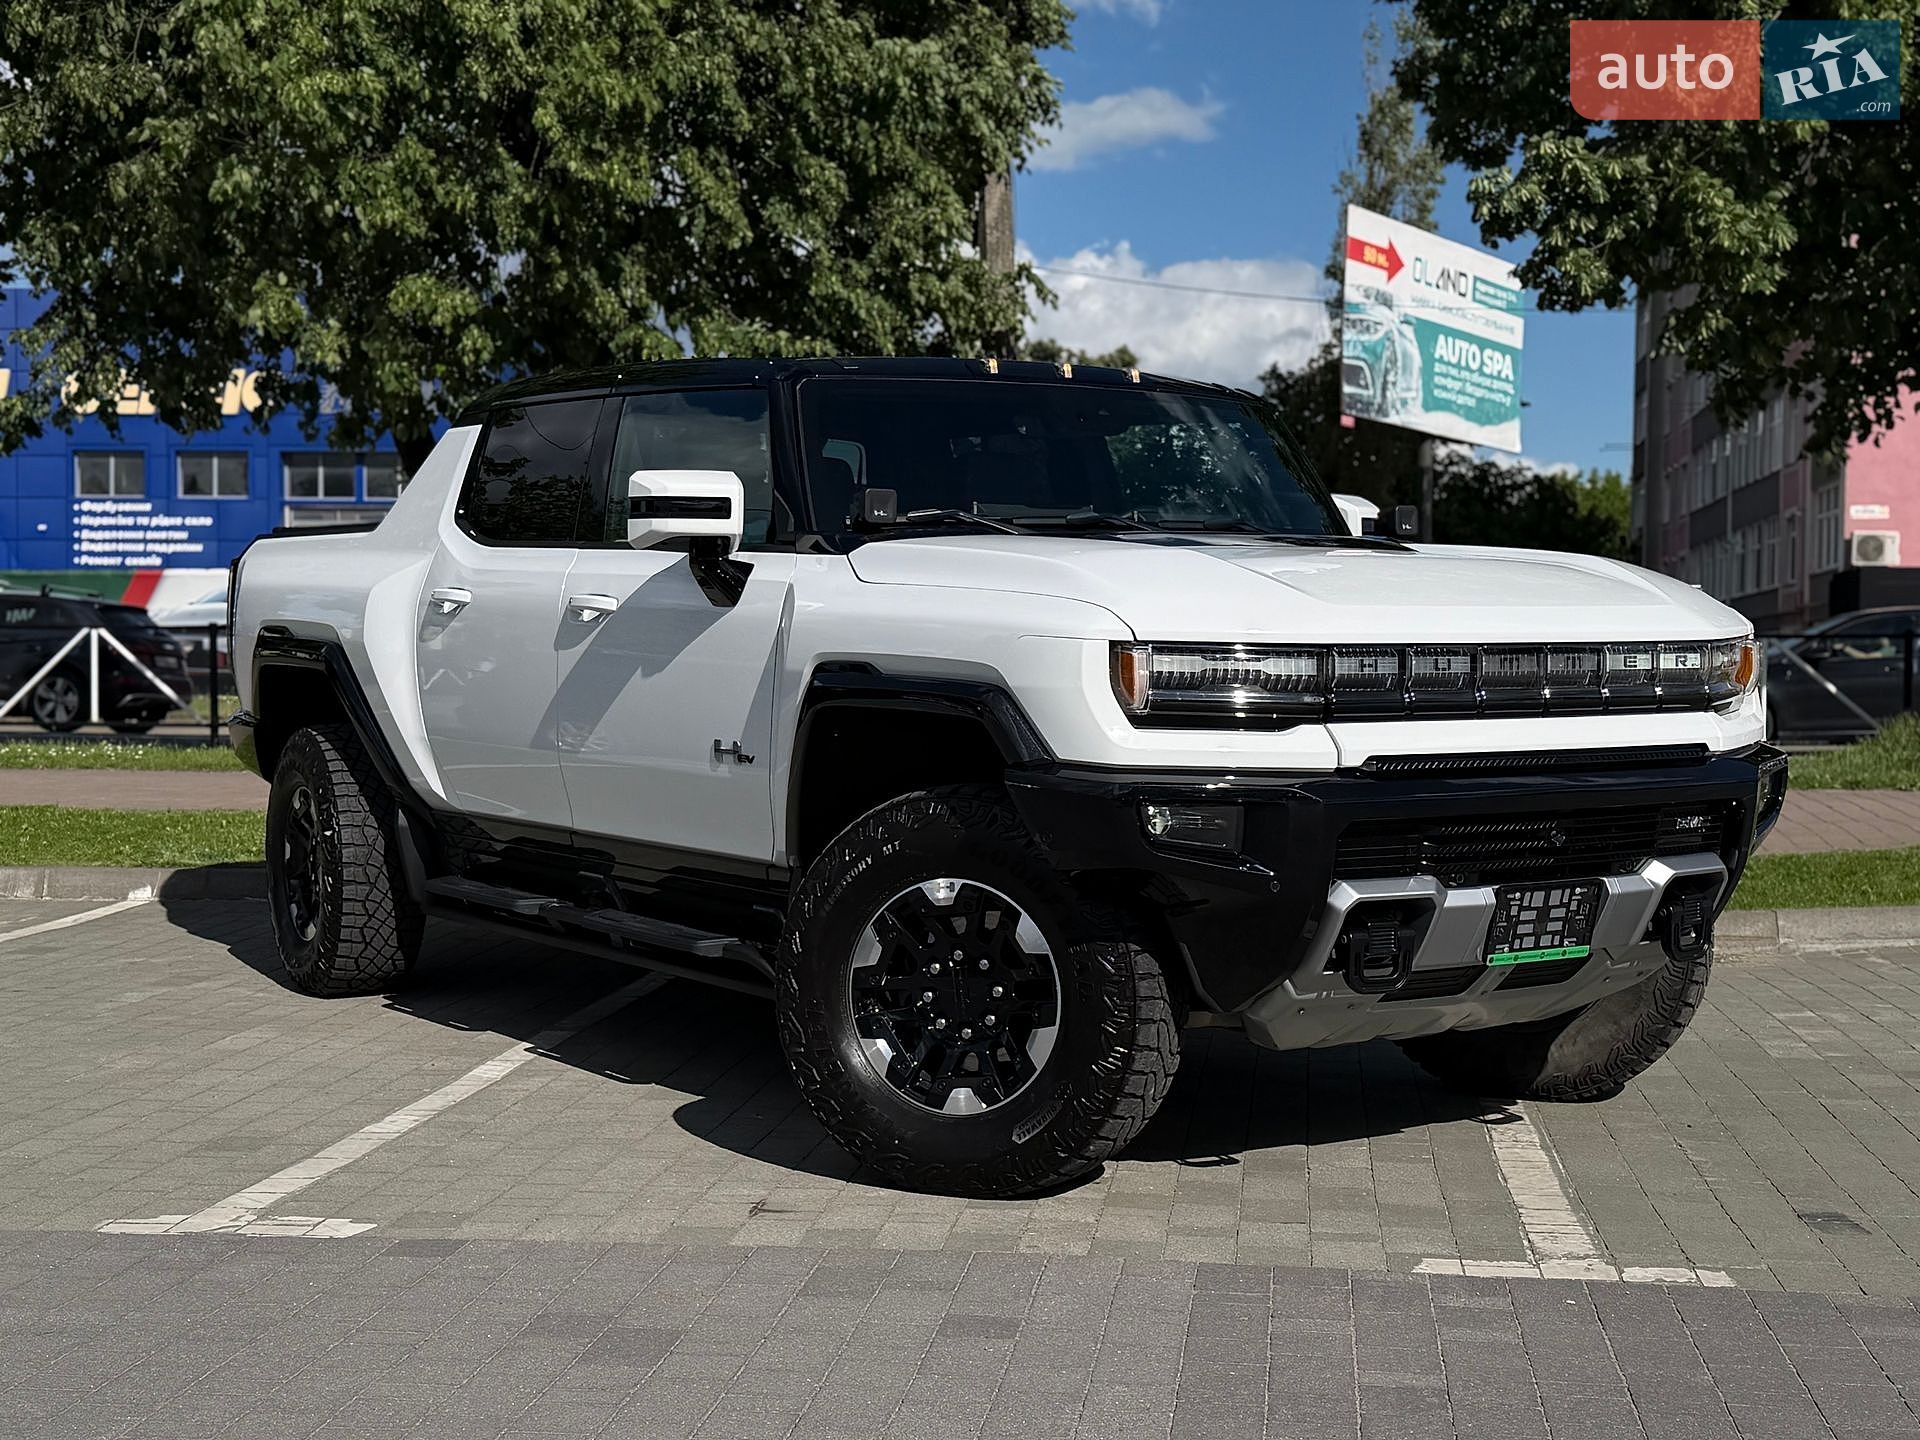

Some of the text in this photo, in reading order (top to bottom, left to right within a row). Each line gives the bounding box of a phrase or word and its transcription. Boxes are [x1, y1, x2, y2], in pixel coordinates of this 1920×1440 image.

[1435, 334, 1513, 381] AUTO SPA
[737, 754, 756, 765] EV
[882, 840, 901, 856] MT
